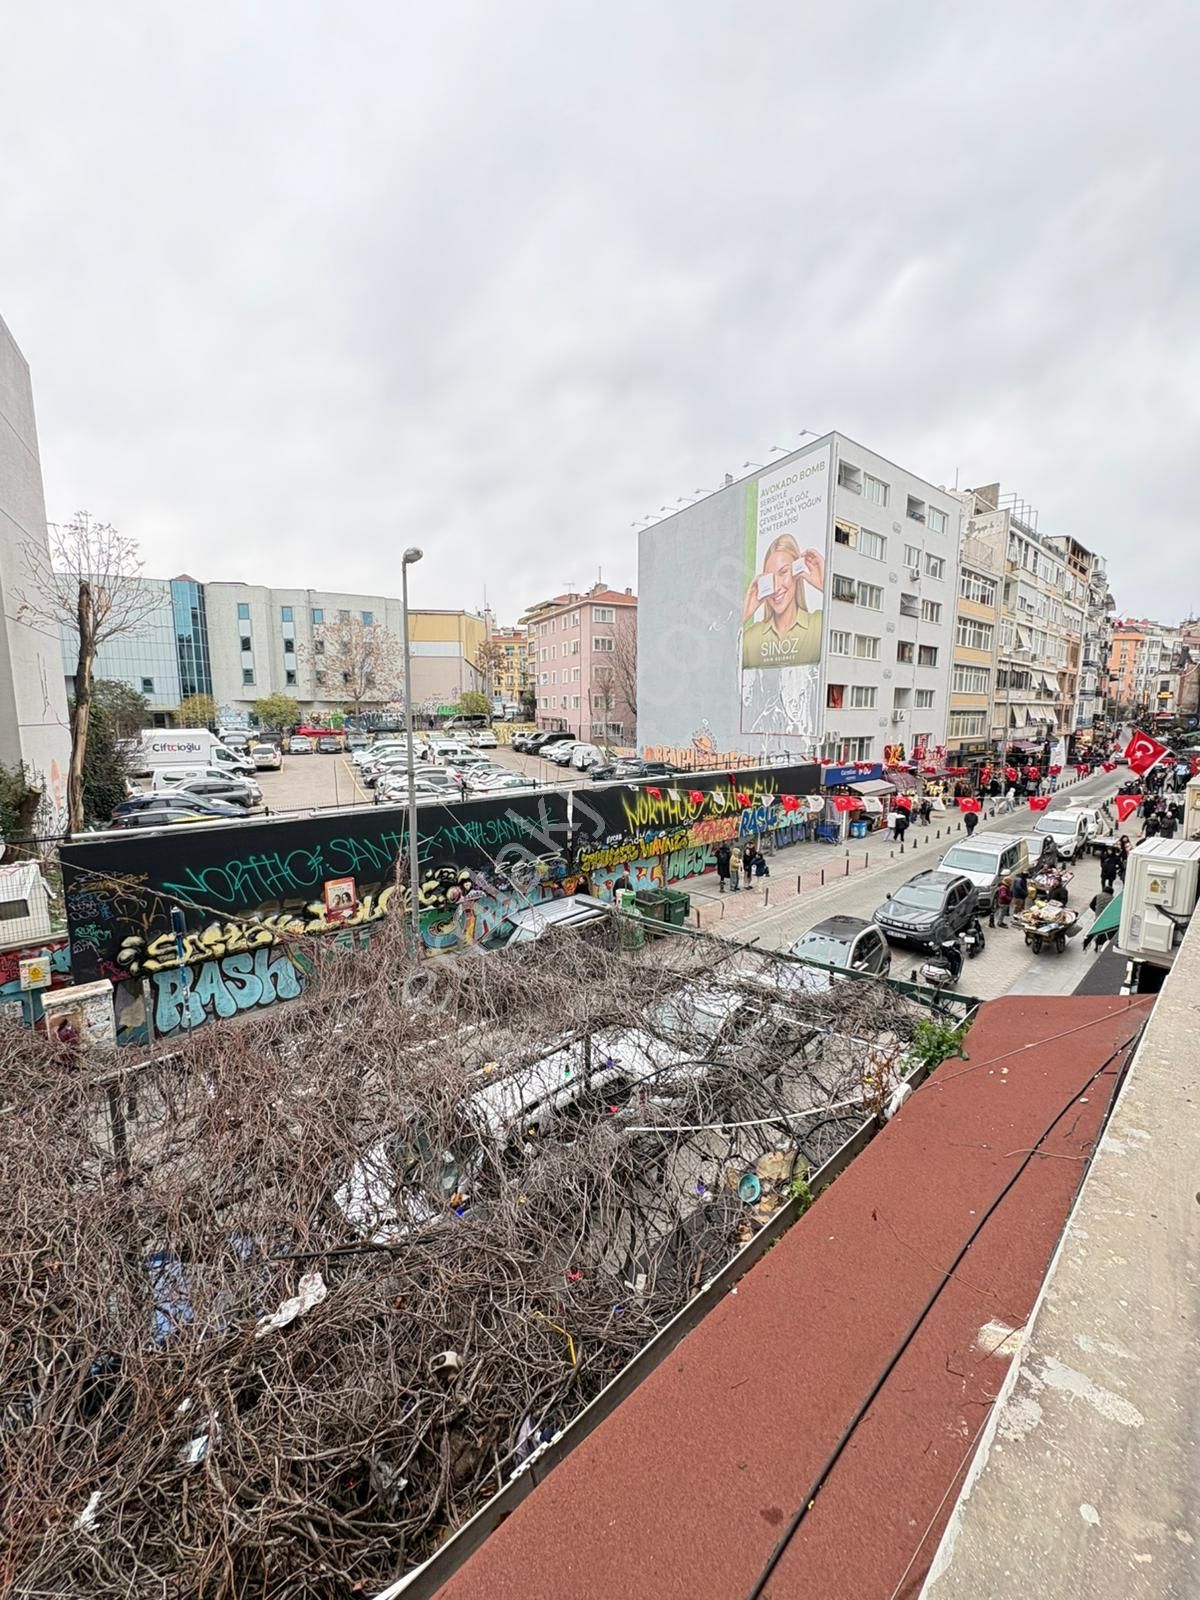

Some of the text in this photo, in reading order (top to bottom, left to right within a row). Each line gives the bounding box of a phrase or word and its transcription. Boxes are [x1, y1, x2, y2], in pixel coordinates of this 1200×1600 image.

[761, 461, 825, 498] AVOKADO BOMB
[786, 497, 794, 505] VE
[759, 525, 772, 535] NEM
